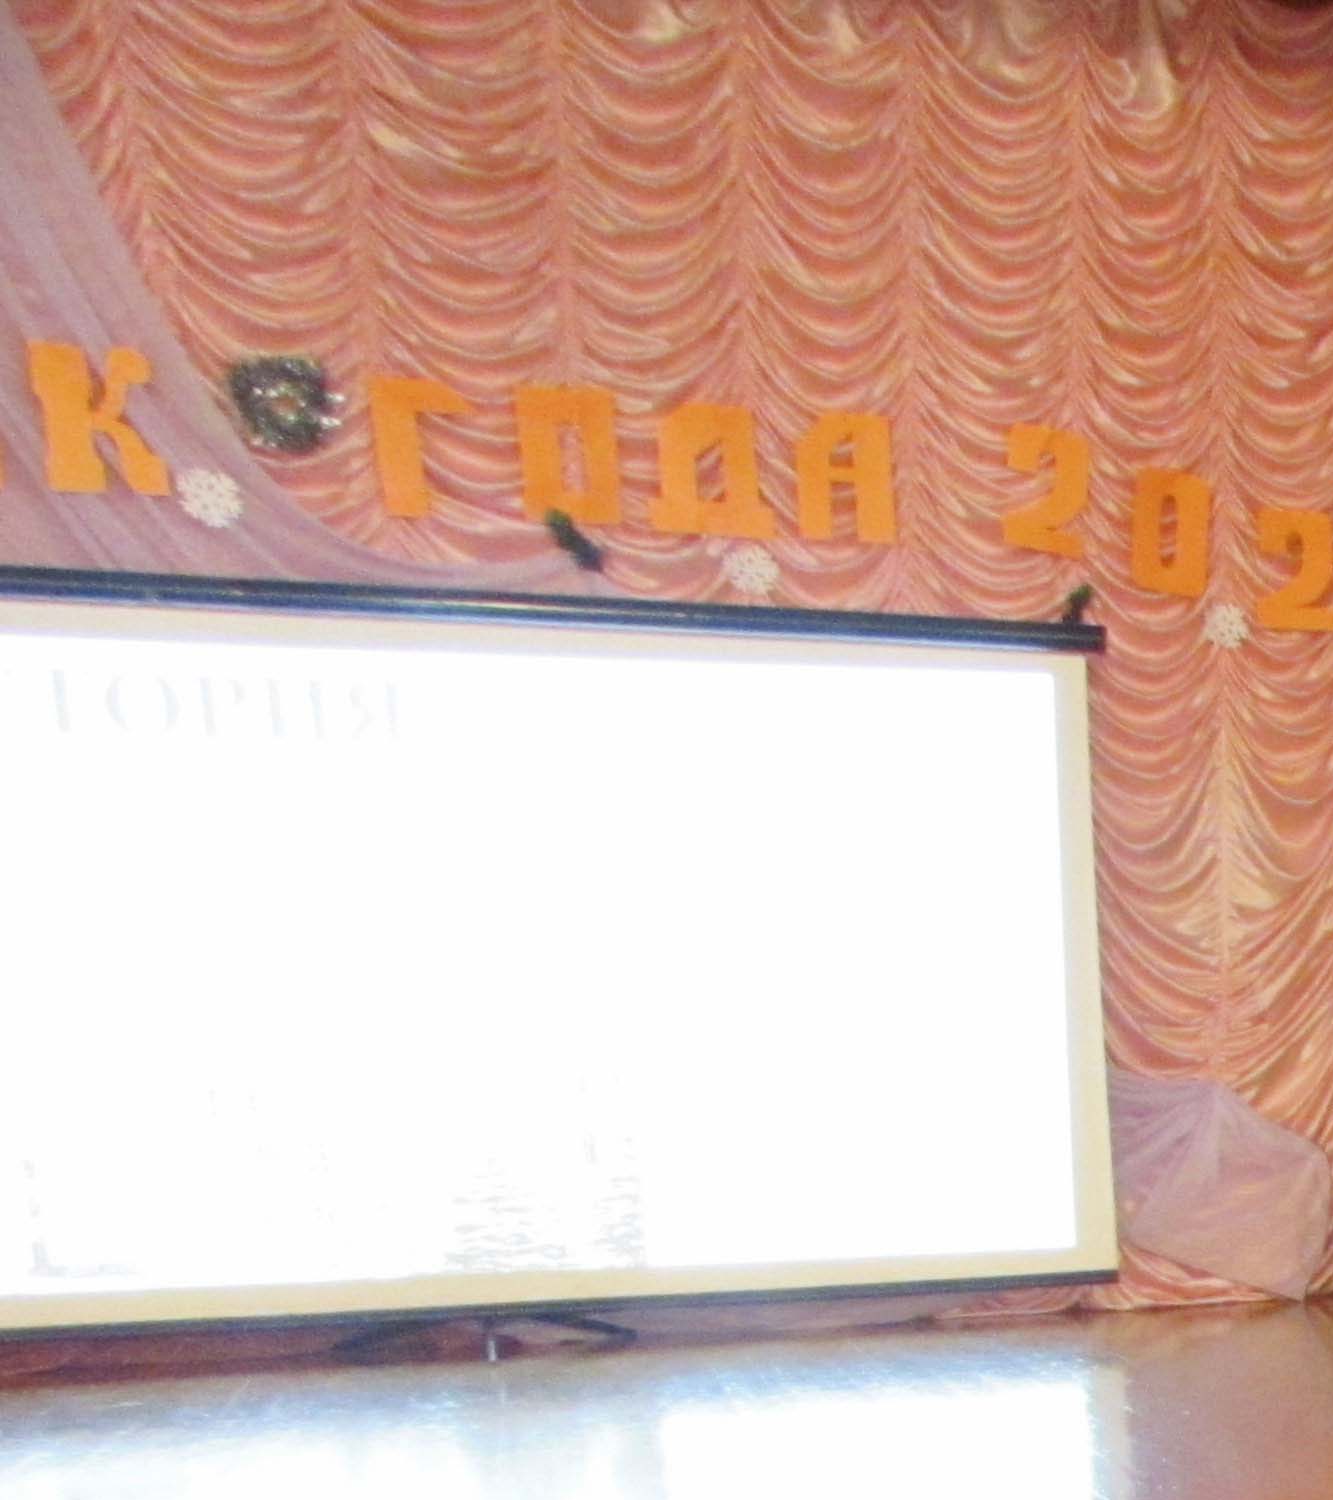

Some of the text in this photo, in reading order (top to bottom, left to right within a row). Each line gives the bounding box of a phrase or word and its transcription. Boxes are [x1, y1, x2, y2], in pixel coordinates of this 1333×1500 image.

[0, 339, 172, 496] К
[369, 374, 897, 543] ГОДА
[2, 665, 402, 742] ТОРИЯ
